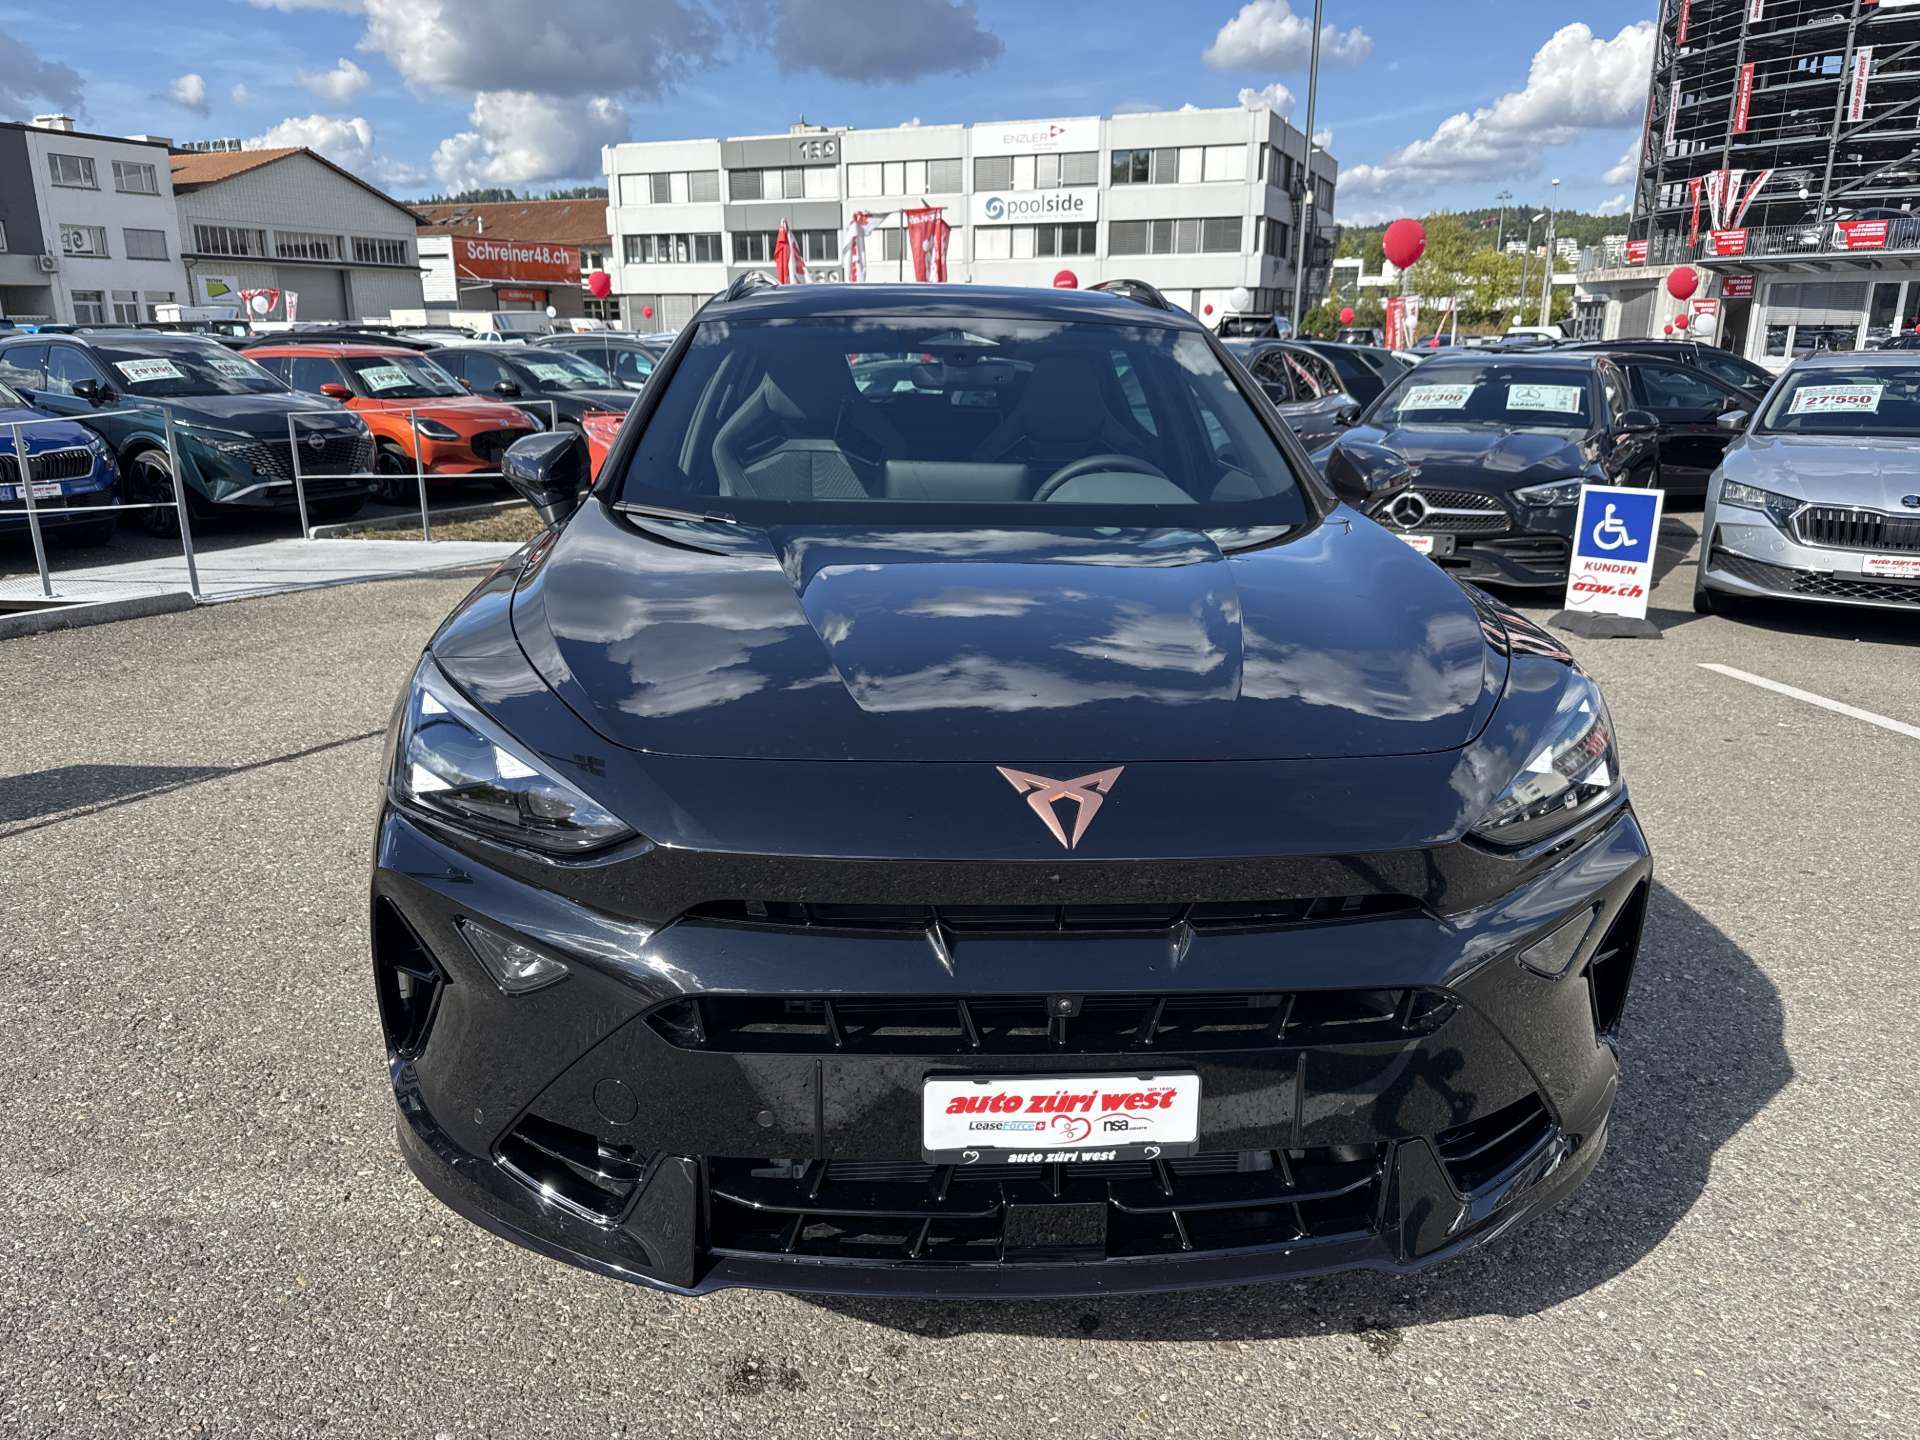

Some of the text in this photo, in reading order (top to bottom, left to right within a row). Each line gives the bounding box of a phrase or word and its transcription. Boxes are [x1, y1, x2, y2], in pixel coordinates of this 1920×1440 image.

[1851, 97, 1861, 120] auto
[1003, 133, 1048, 144] ENZLER
[1008, 194, 1084, 220] poolside
[467, 241, 570, 265] Schreiner48.ch
[1805, 395, 1872, 405] 27'550
[1584, 561, 1637, 575] KUNDEN
[1572, 582, 1643, 598] azw.ch
[945, 1088, 1178, 1115] auto züri west
[968, 1120, 1035, 1131] LeaseForce
[1103, 1120, 1129, 1132] nsa
[1007, 1150, 1116, 1163] auto züri west
